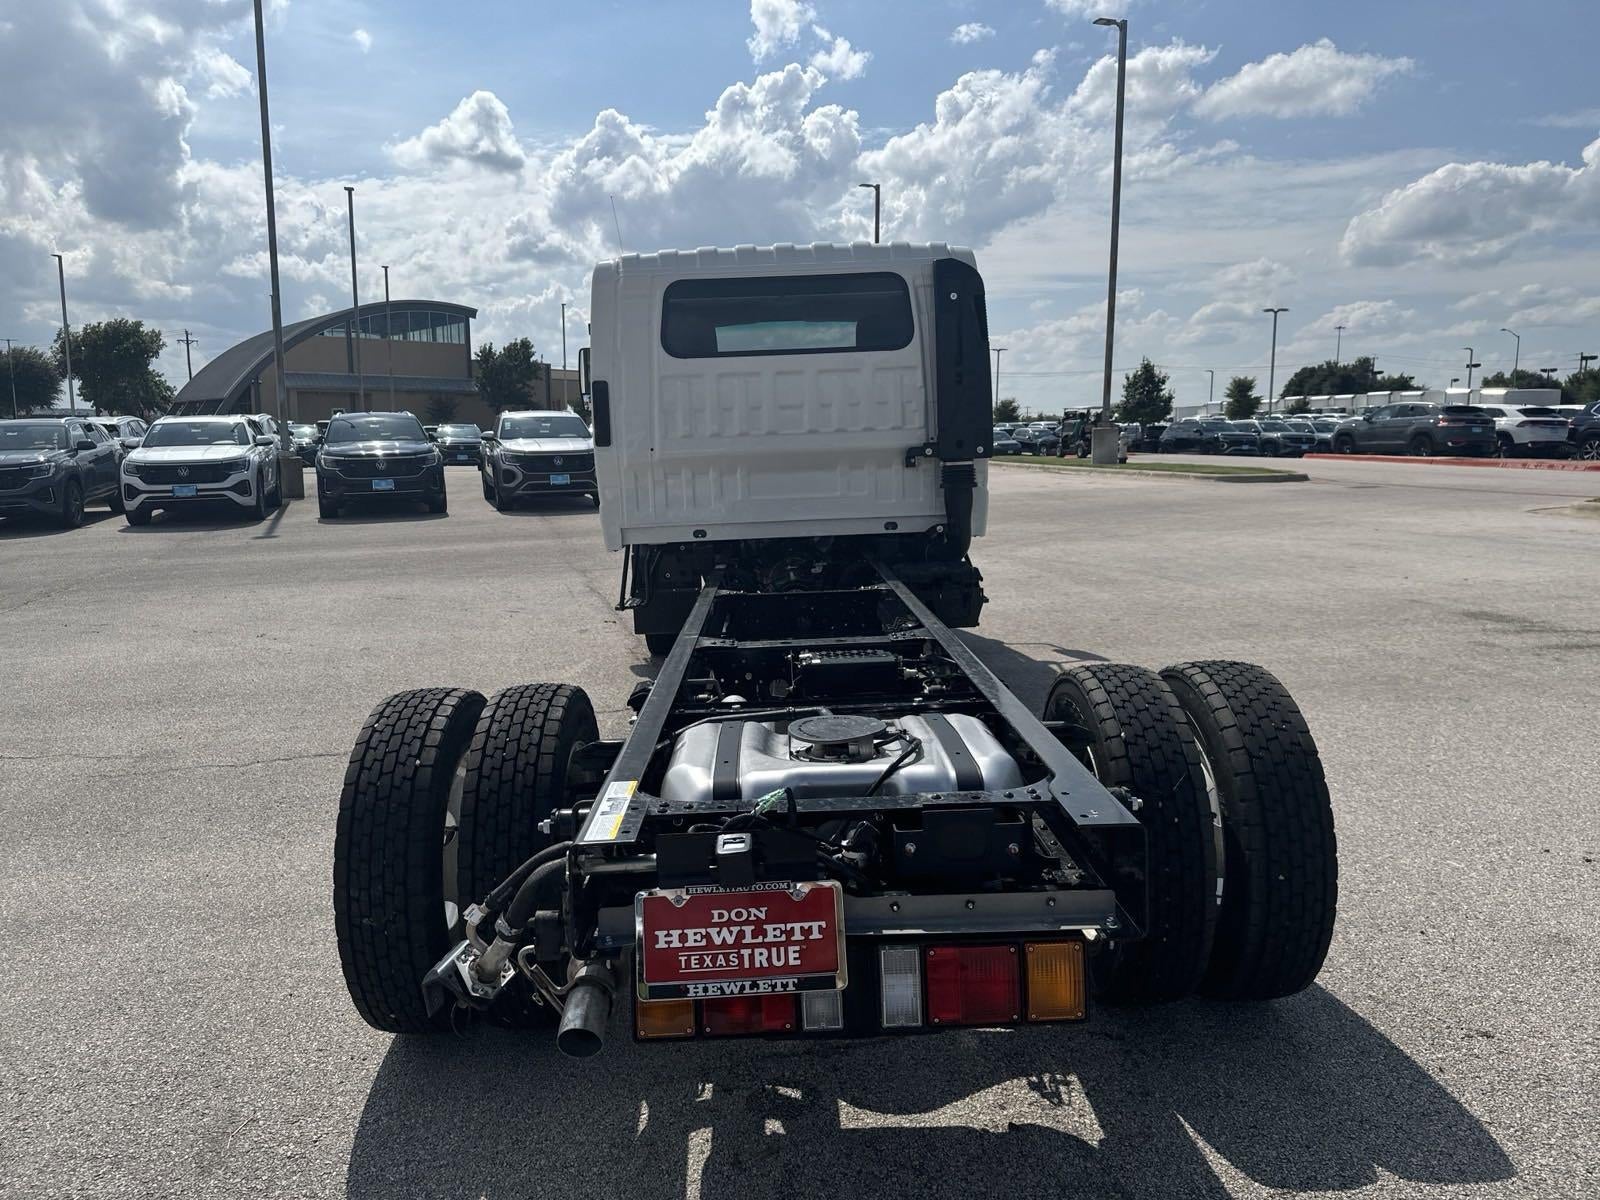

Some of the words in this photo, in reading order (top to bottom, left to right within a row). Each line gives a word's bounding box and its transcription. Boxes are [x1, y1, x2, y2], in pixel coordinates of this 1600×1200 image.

[711, 907, 768, 923] DON
[654, 921, 826, 948] HEWLETT
[686, 978, 798, 997] HEWLETT
